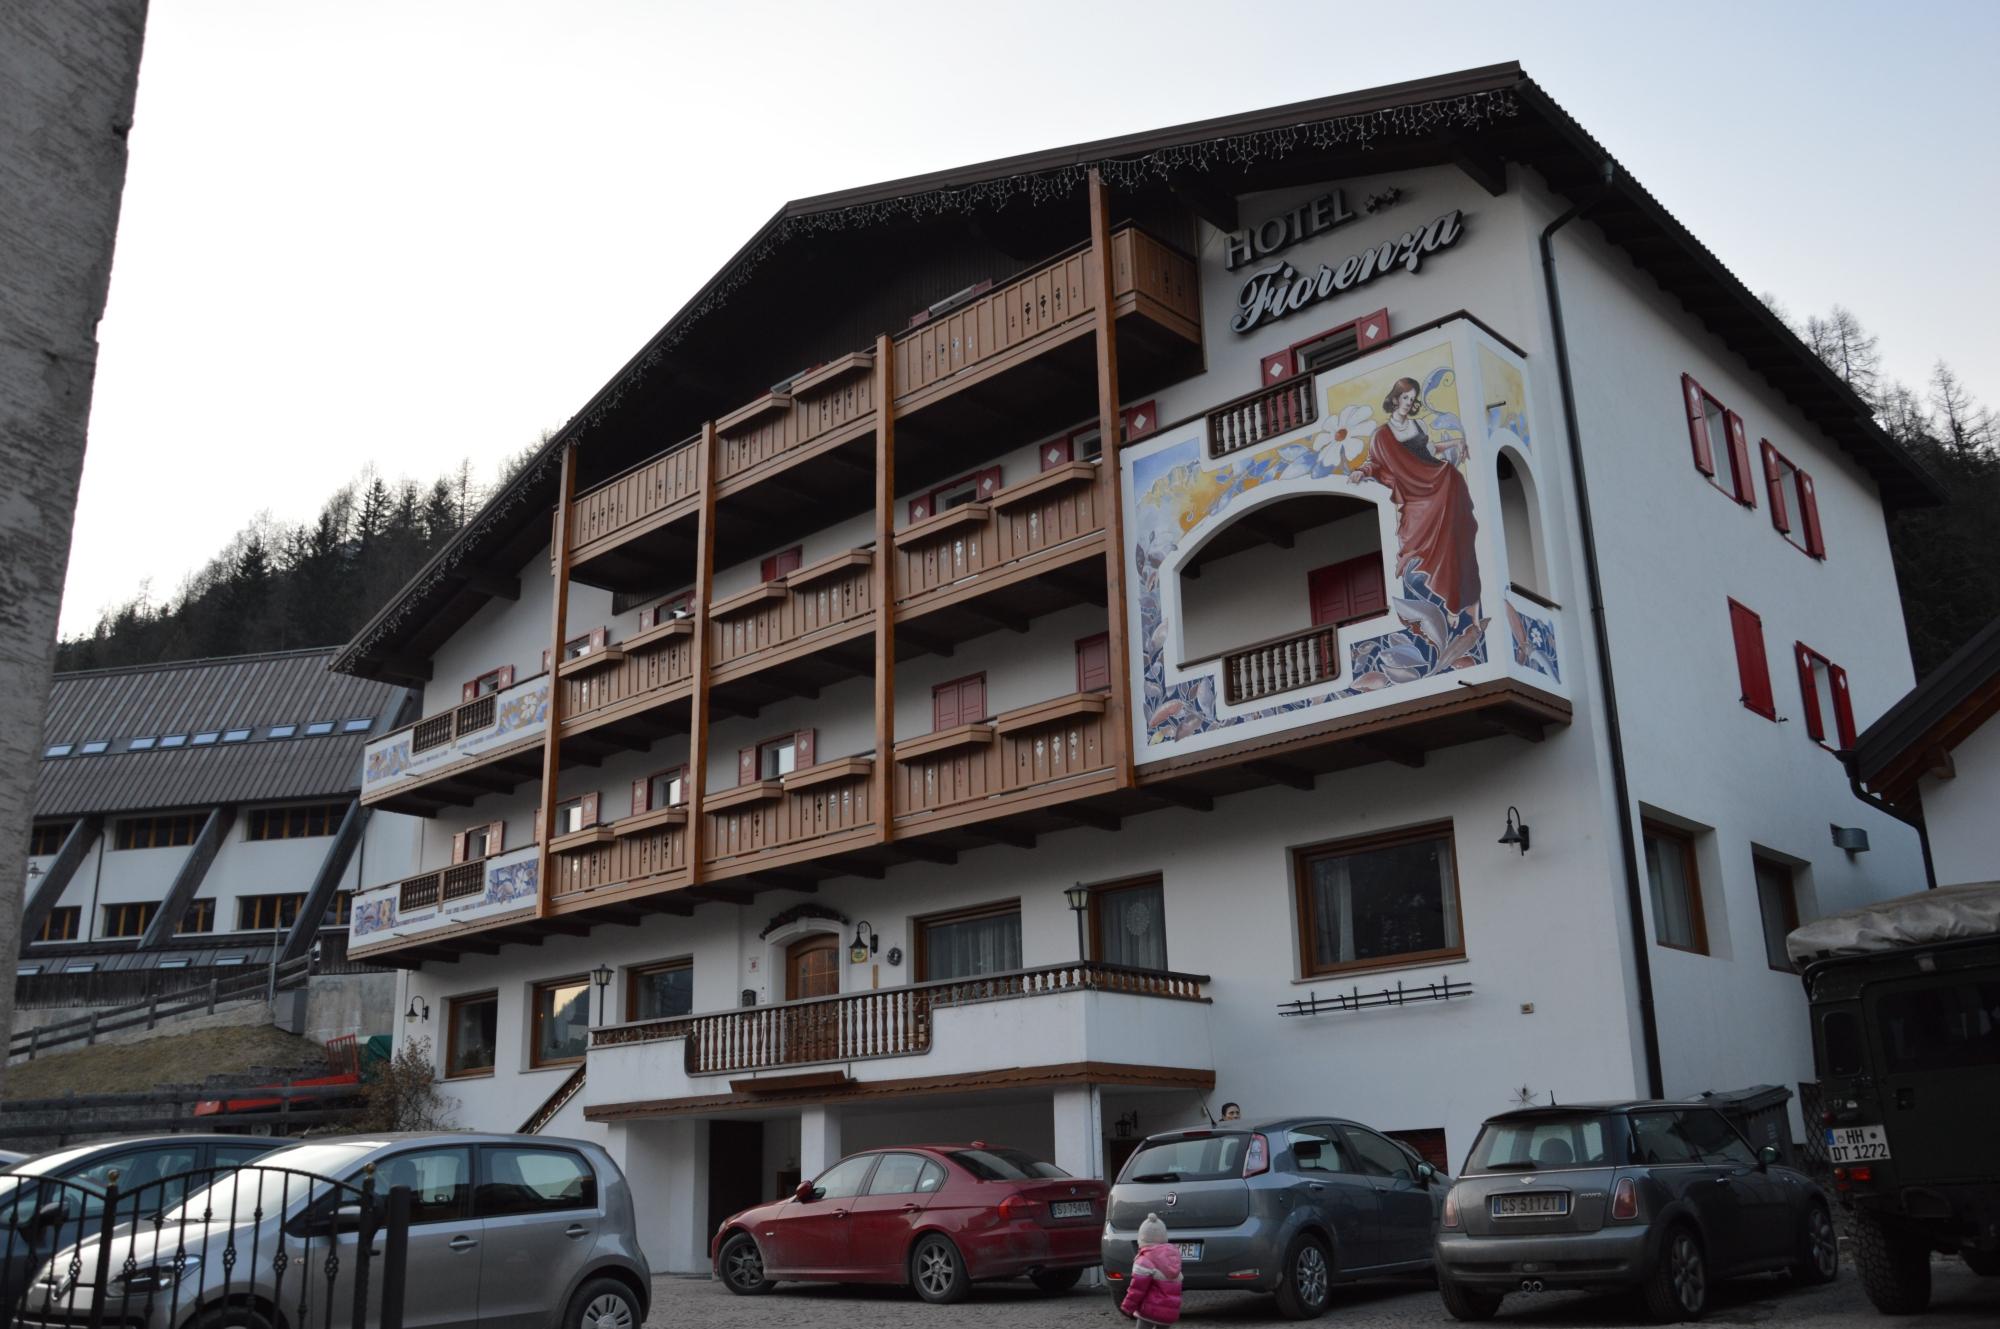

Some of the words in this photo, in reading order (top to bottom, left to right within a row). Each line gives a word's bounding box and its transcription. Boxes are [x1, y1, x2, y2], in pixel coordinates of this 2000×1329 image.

[1224, 189, 1355, 271] HOTEL
[1230, 209, 1464, 334] Fiorenza
[1845, 1129, 1865, 1144] HH
[1831, 1146, 1849, 1161] DT
[1852, 1143, 1888, 1160] 1272
[1501, 1198, 1516, 1212] CS
